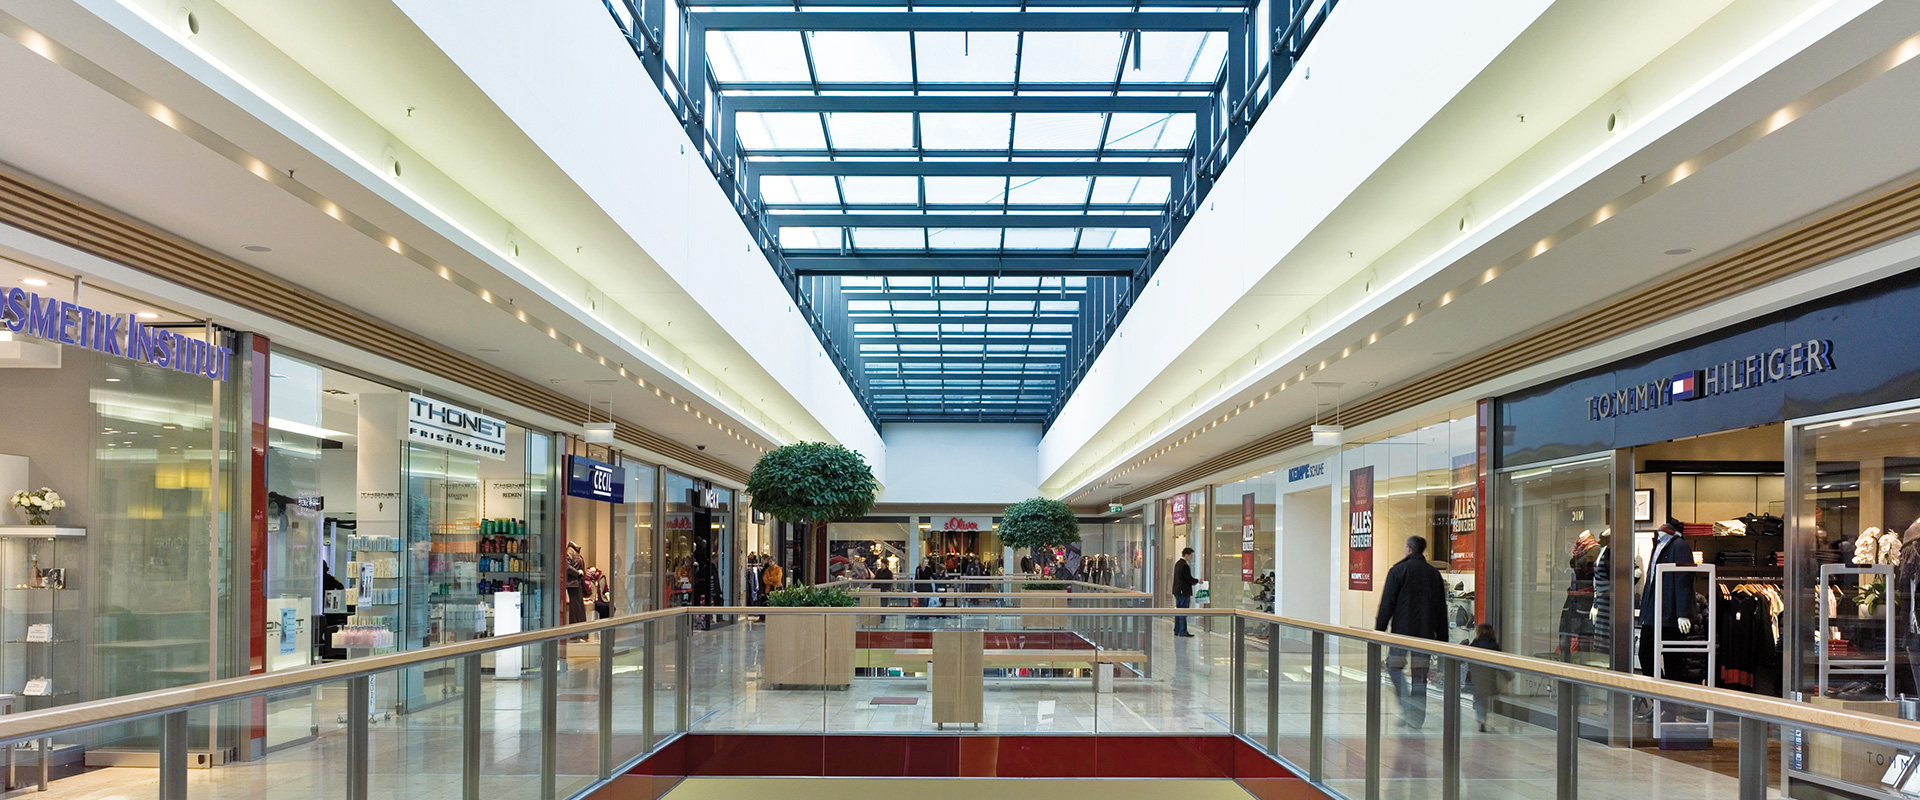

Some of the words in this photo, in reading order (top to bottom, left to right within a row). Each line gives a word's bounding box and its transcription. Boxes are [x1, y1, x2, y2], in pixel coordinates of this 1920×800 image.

[127, 313, 232, 382] INSTITUT
[1585, 377, 1672, 421] TOMMY
[1704, 339, 1829, 396] HILFIGER
[410, 397, 506, 438] THONET
[593, 470, 612, 492] CECIL
[1454, 497, 1476, 518] ALLES
[944, 517, 979, 530] s.Oliver
[1352, 510, 1372, 534] ALLES
[1350, 533, 1373, 549] REDUZIERT
[1866, 751, 1920, 774] TOMMY
